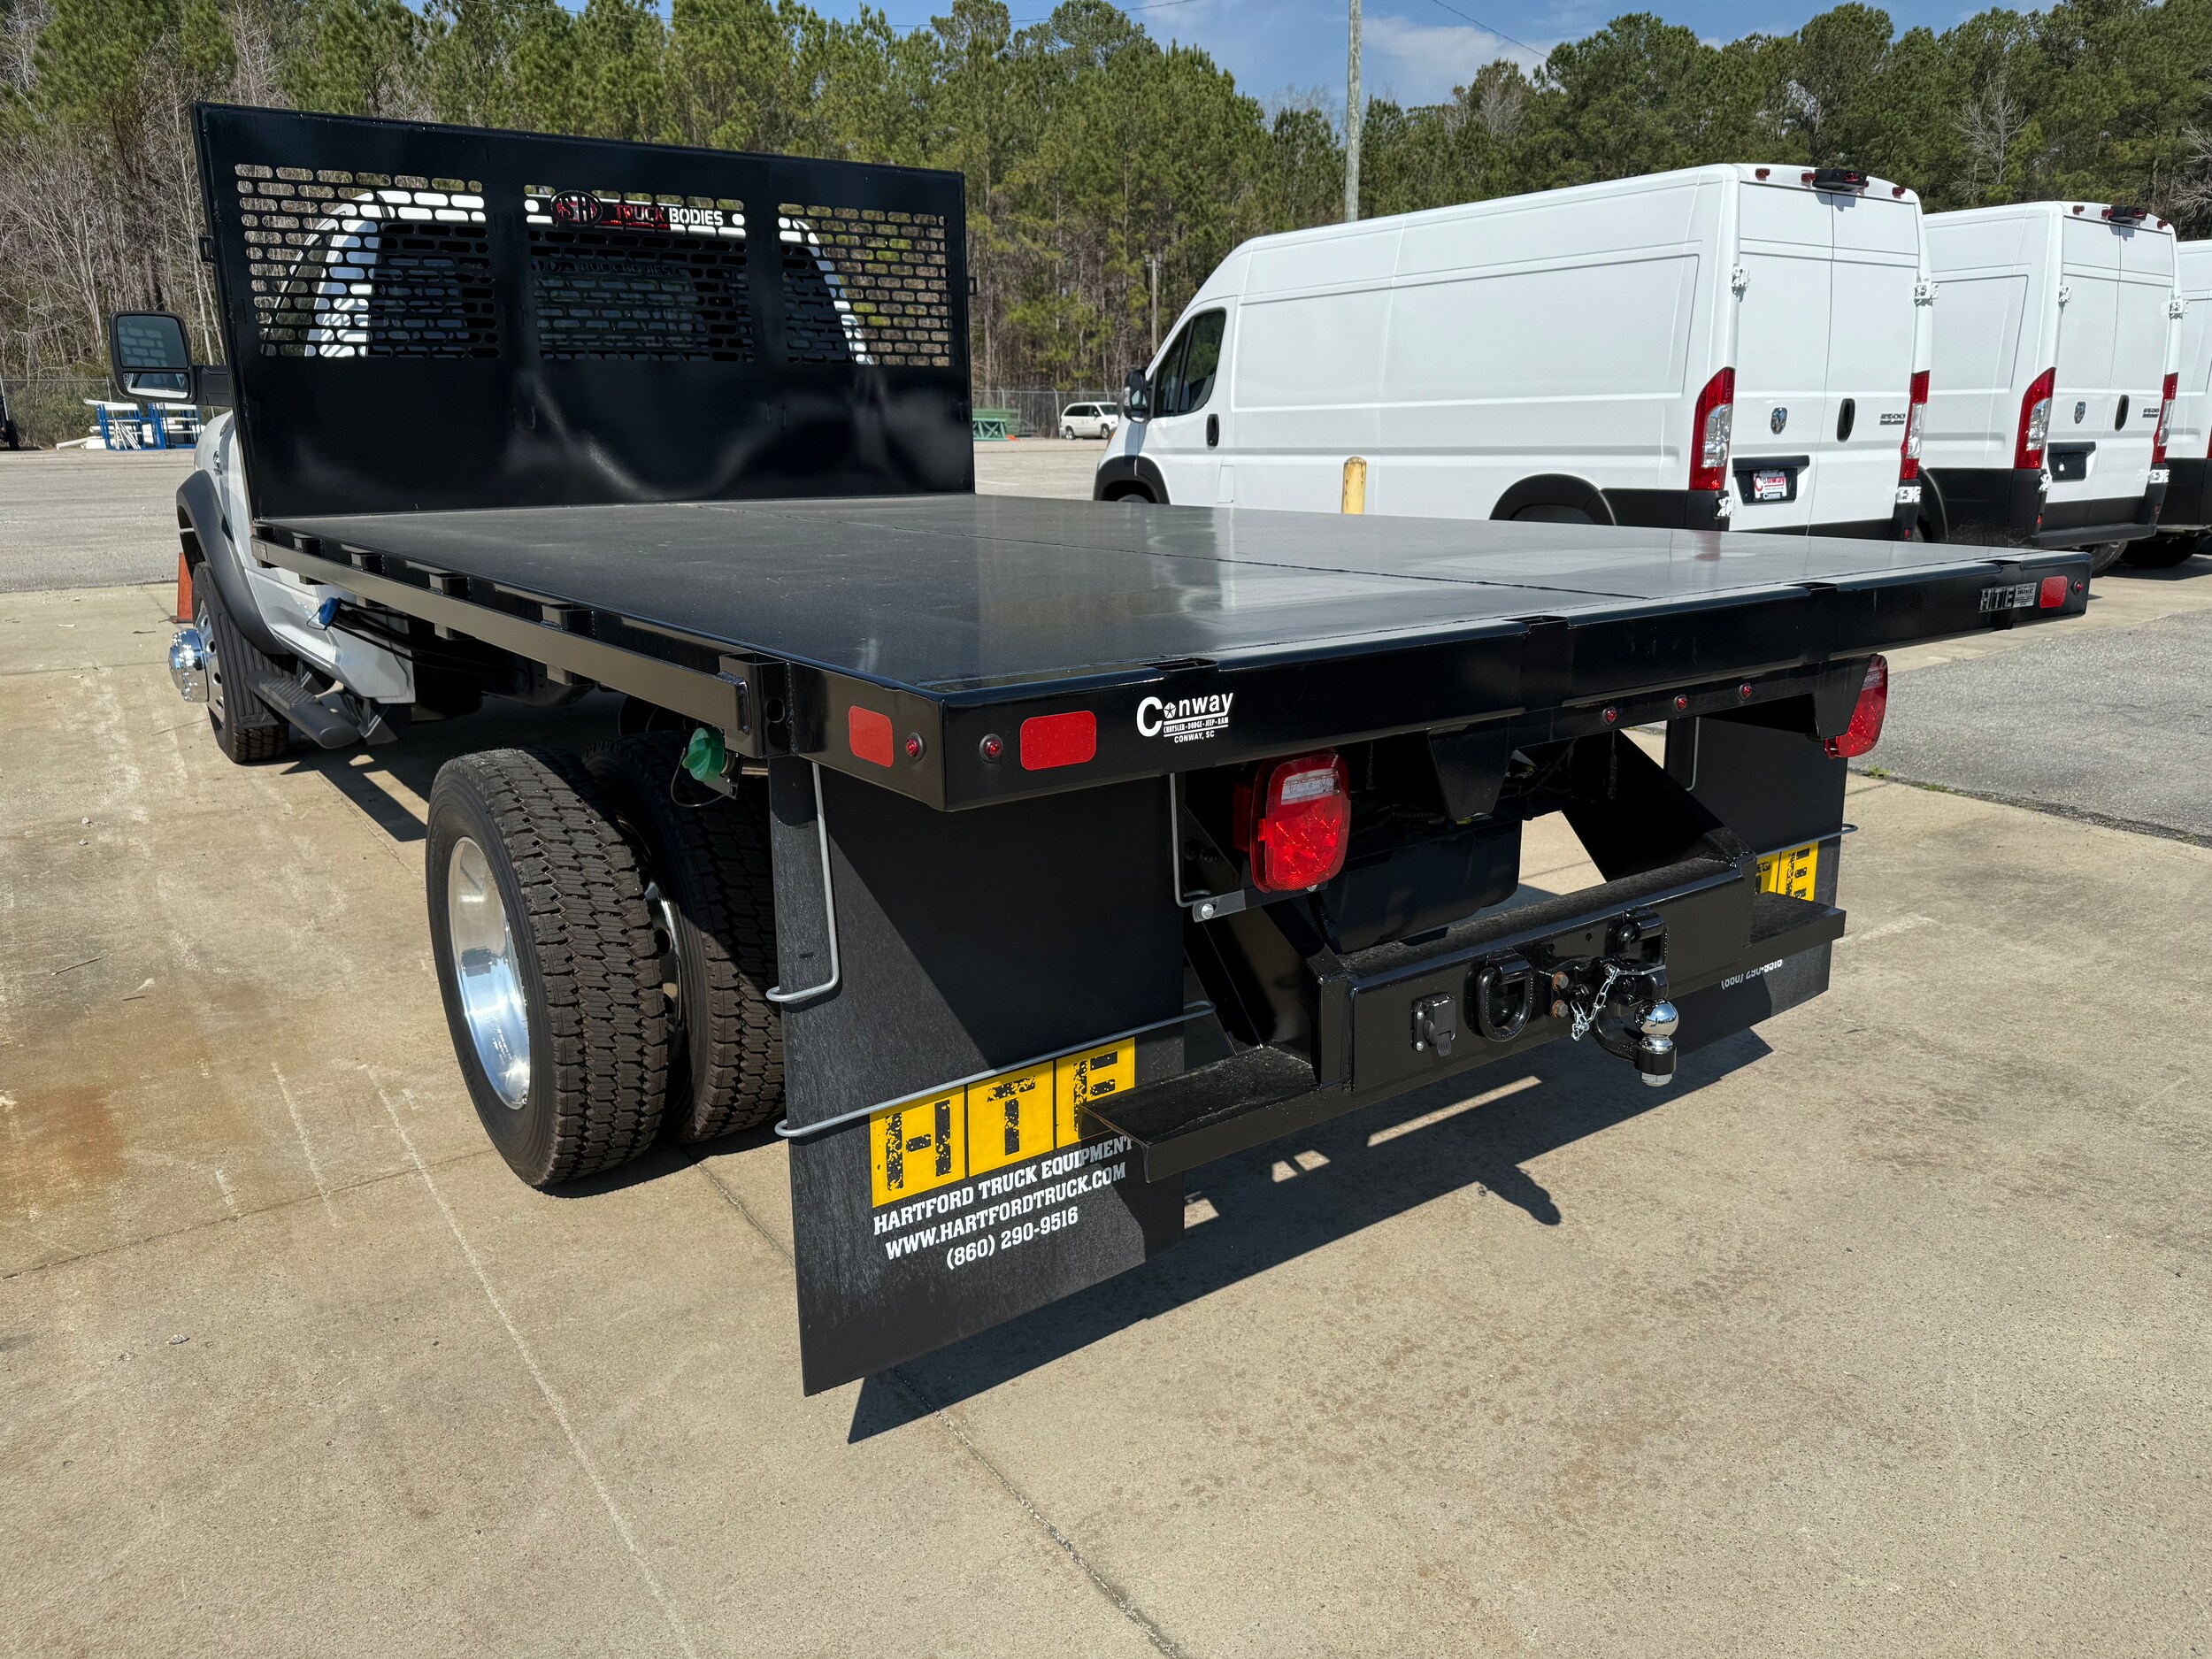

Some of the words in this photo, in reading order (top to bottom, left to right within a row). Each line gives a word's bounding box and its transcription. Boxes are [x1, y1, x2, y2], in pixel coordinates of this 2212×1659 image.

[612, 204, 665, 223] TRUCK
[668, 207, 724, 227] BODIES
[1979, 587, 2014, 611] HTE
[1163, 724, 1186, 734] CHRYSLER
[1187, 720, 1203, 730] DODGE
[1204, 718, 1216, 727] JEEP
[1217, 716, 1229, 726] RAM
[1173, 733, 1204, 744] CONWAY,
[1205, 730, 1215, 739] SC
[872, 1186, 974, 1236] HARTFORD
[978, 1164, 1038, 1201] TRUCK
[1041, 1134, 1133, 1179] EQUIPMENT
[884, 1161, 1126, 1261] WWW.HARTFORDTRUCK.COM
[945, 1233, 996, 1271] (860)
[1000, 1205, 1079, 1250] 290-9516
